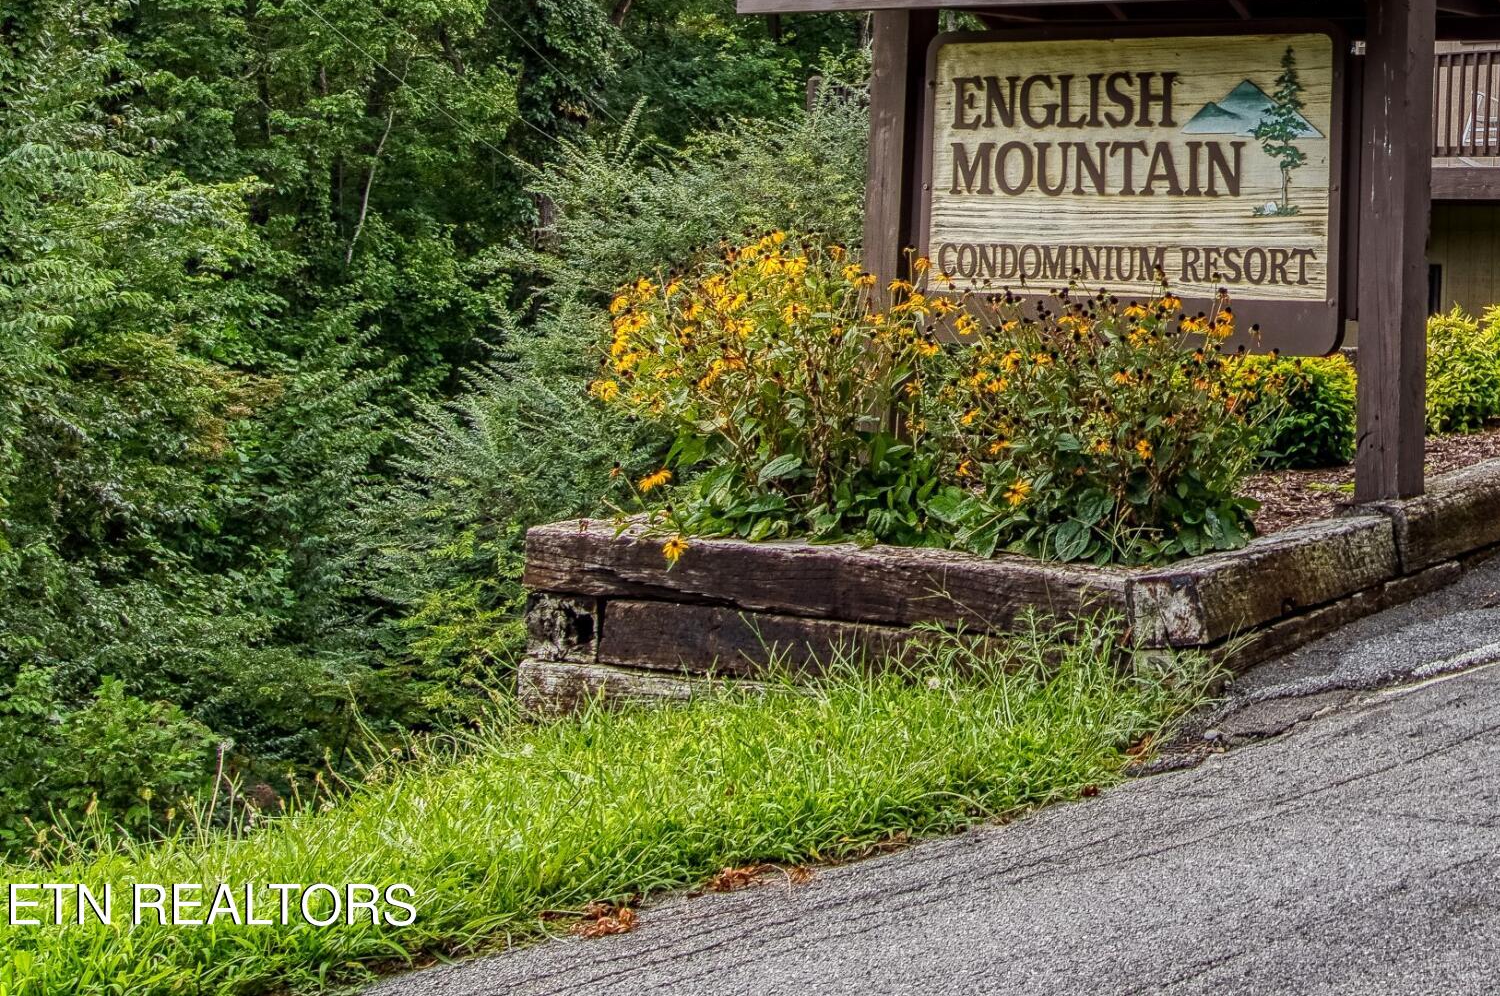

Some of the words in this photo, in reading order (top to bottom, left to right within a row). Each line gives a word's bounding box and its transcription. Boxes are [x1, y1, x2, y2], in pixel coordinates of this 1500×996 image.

[951, 71, 1180, 130] ENGLISH
[949, 140, 1247, 197] MOUNTAIN
[938, 242, 1166, 281] CONDOMINIUM
[1179, 246, 1317, 286] RESORT
